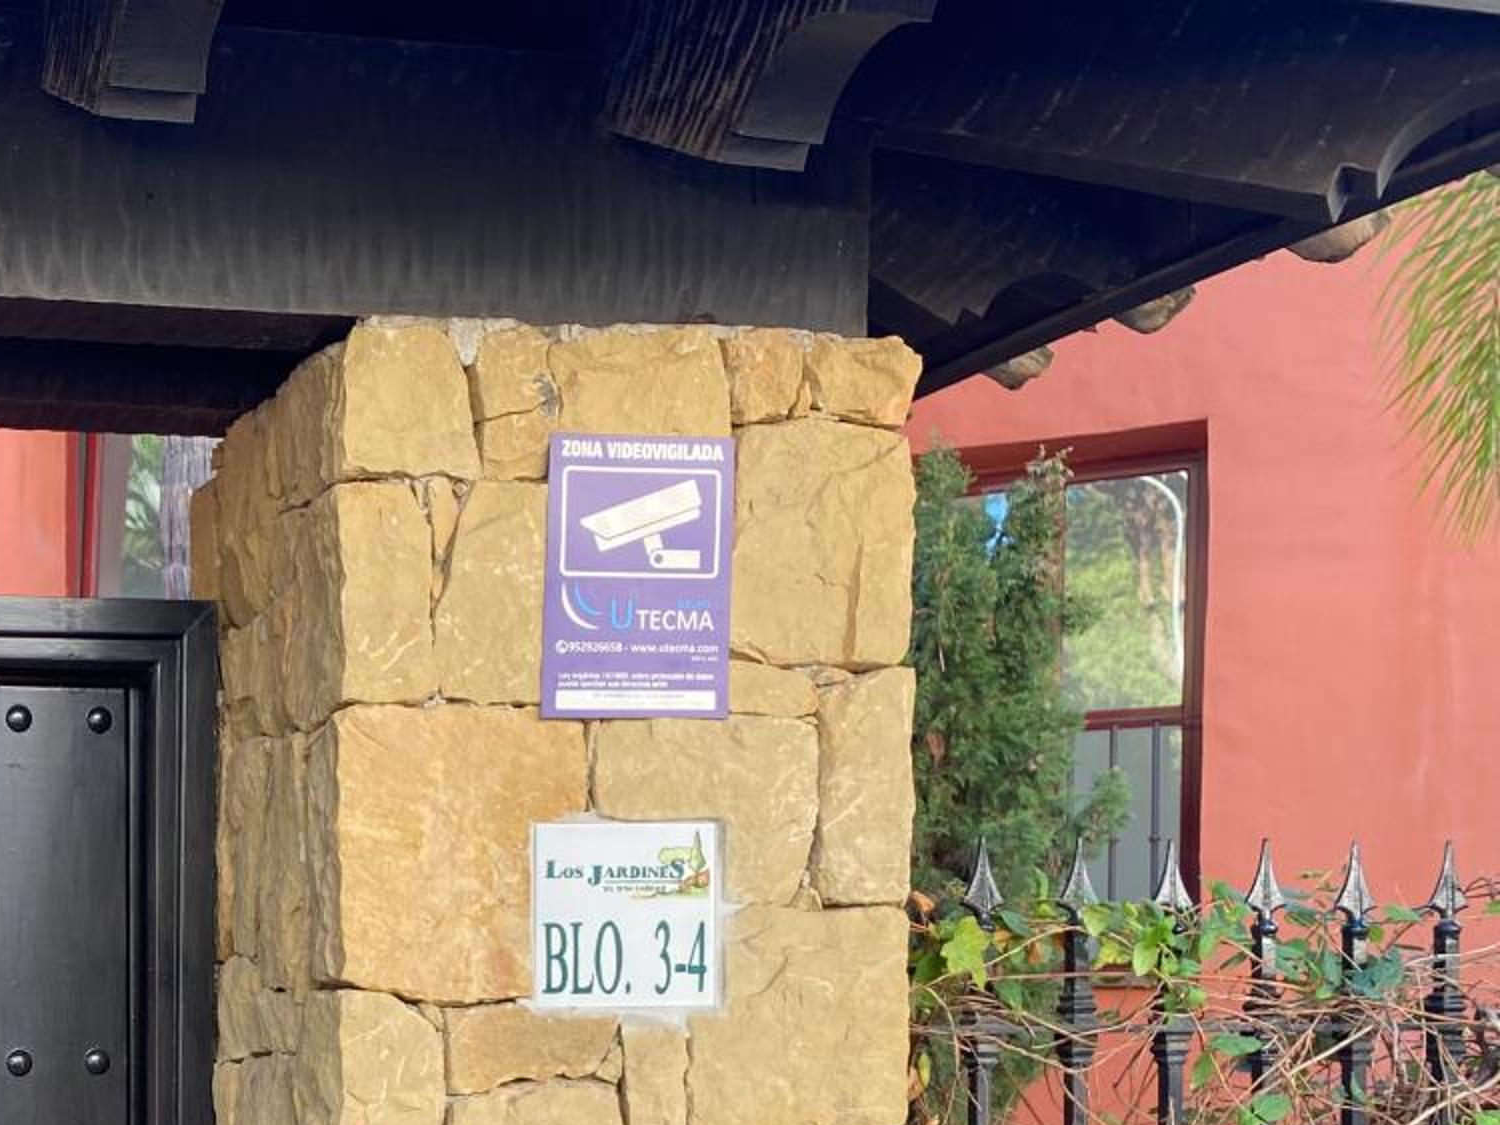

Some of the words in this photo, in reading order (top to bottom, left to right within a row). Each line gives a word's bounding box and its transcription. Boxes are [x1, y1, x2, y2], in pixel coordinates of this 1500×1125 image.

[561, 439, 603, 459] ZONA
[607, 441, 724, 462] VIDEOVIGILADA
[611, 595, 714, 631] UTECMA
[542, 920, 631, 995] BLO.
[654, 919, 707, 995] 3-4
